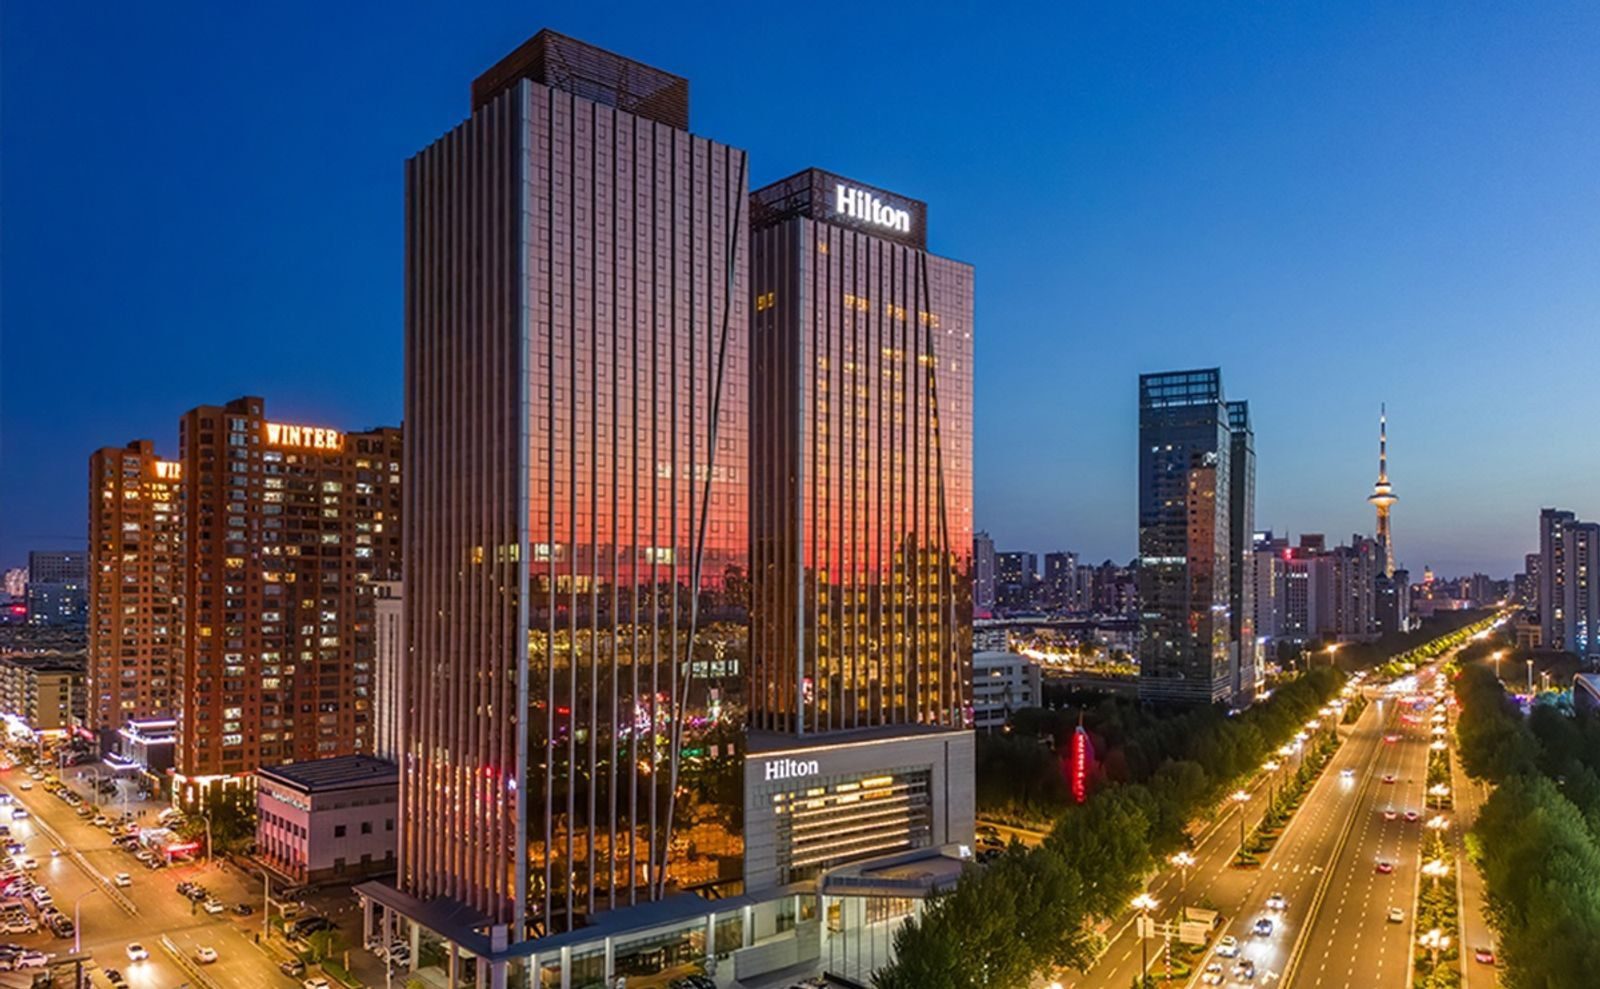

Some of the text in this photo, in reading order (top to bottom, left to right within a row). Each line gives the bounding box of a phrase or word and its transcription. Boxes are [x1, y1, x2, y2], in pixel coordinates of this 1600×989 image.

[836, 184, 910, 233] Hilton
[266, 423, 337, 449] WINTER
[765, 758, 819, 781] Hilton
